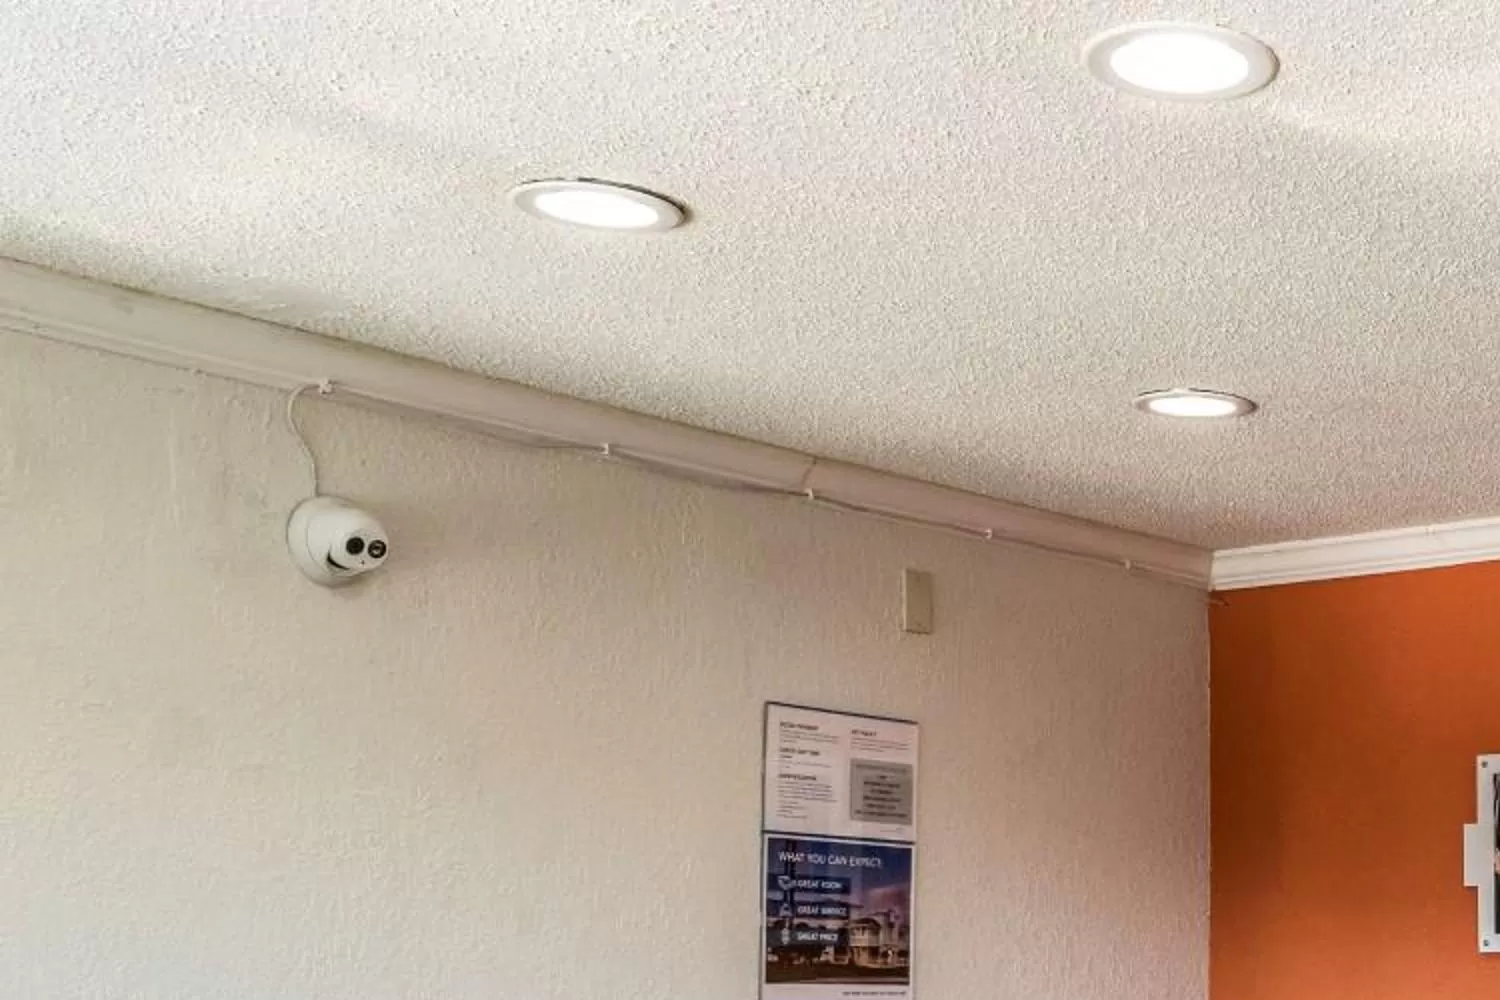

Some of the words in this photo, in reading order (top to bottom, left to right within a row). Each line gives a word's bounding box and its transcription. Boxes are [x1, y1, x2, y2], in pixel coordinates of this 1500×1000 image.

[778, 851, 804, 863] WHAT
[807, 853, 826, 865] YOU
[827, 855, 847, 866] CAN
